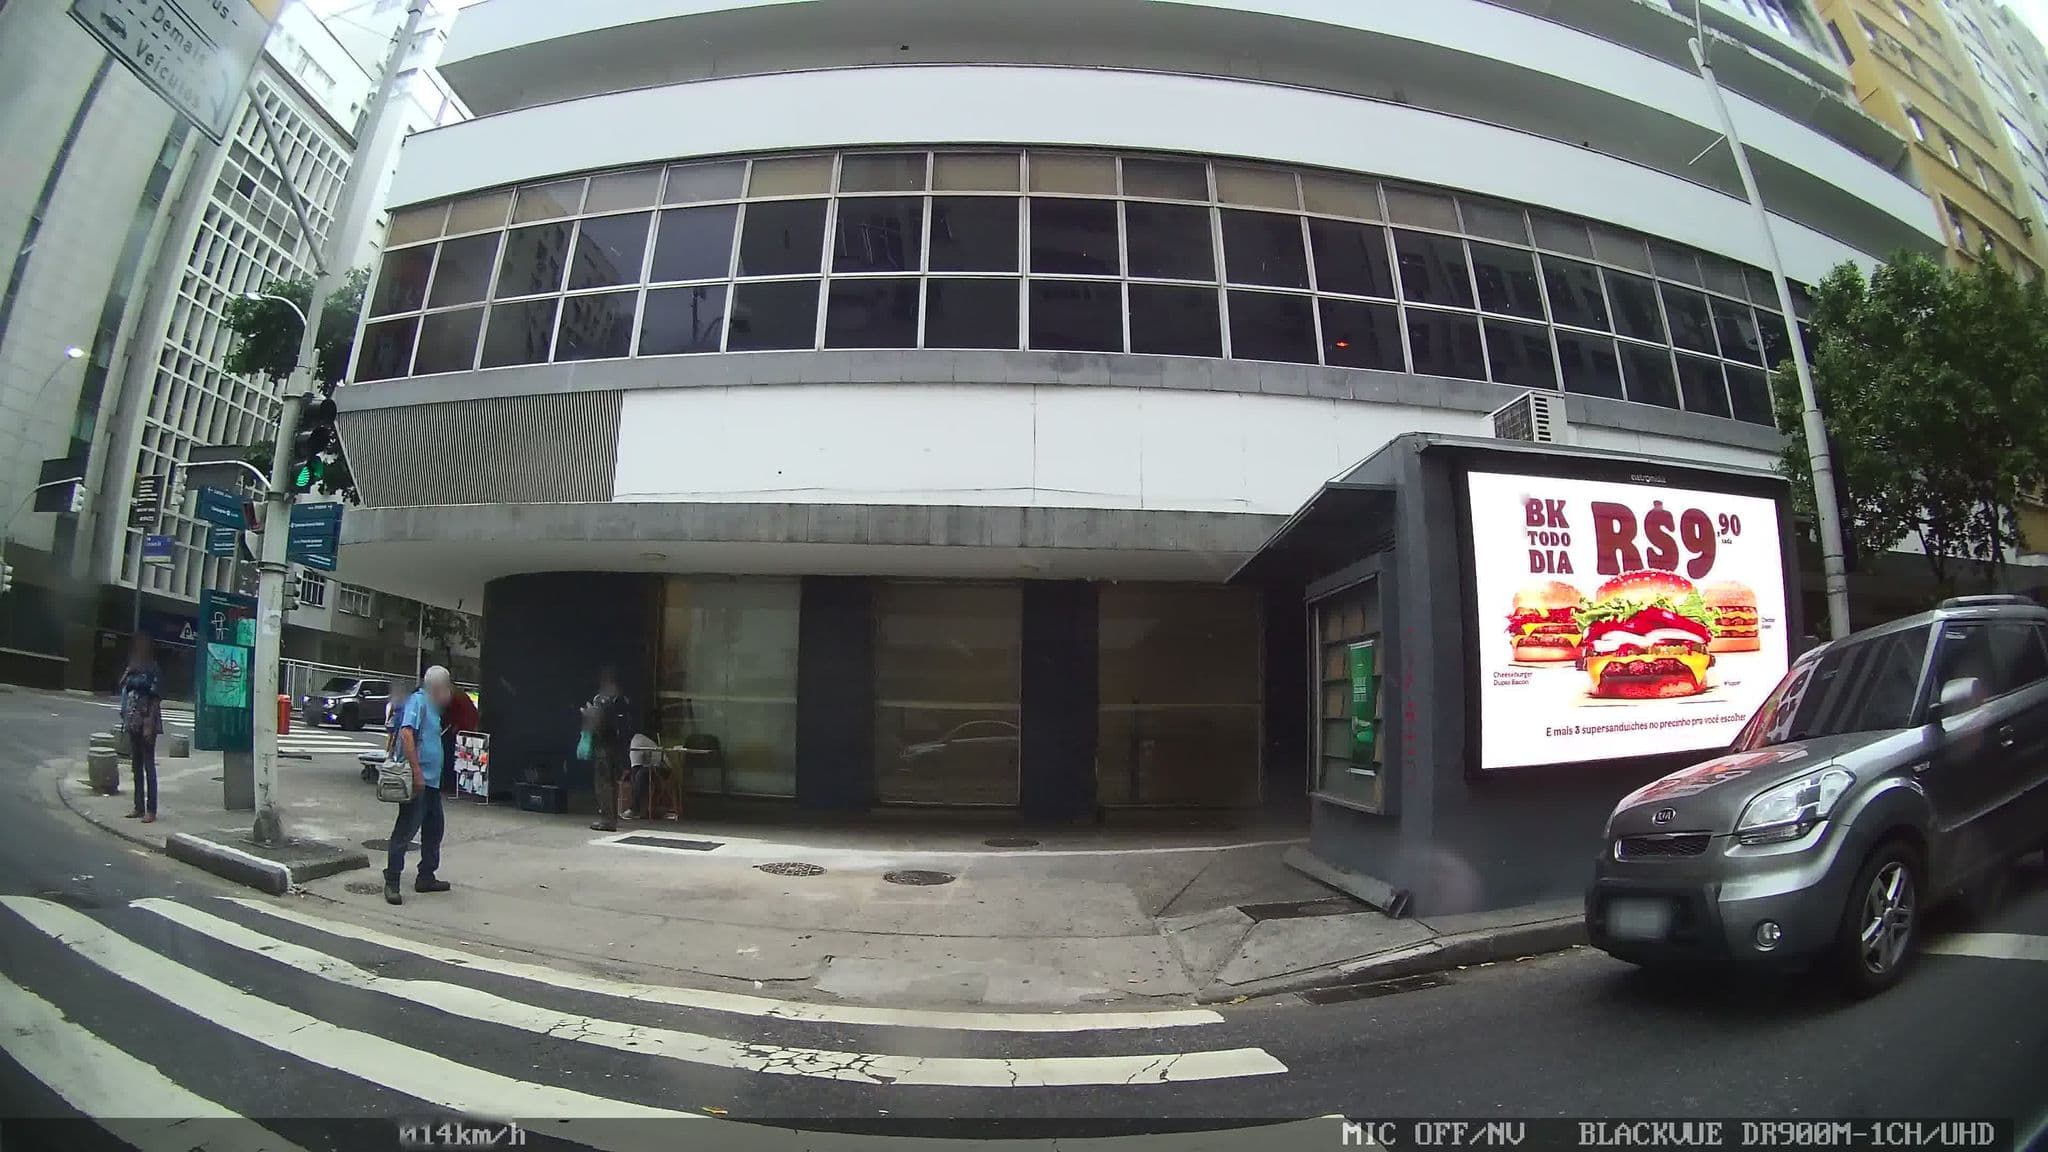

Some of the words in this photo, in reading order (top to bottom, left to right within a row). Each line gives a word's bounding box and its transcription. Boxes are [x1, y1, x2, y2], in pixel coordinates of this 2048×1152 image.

[150, 5, 206, 66] Demais
[1525, 497, 1570, 529] BK
[1527, 530, 1571, 547] TODO
[1529, 549, 1574, 575] DIA
[1546, 727, 1552, 737] E
[1553, 725, 1573, 737] mais
[1575, 725, 1581, 735] 3
[1649, 721, 1659, 729] no
[1659, 718, 1691, 731] precinho
[1691, 717, 1703, 727] pra
[1704, 714, 1719, 724] você
[1720, 712, 1746, 723] escolher
